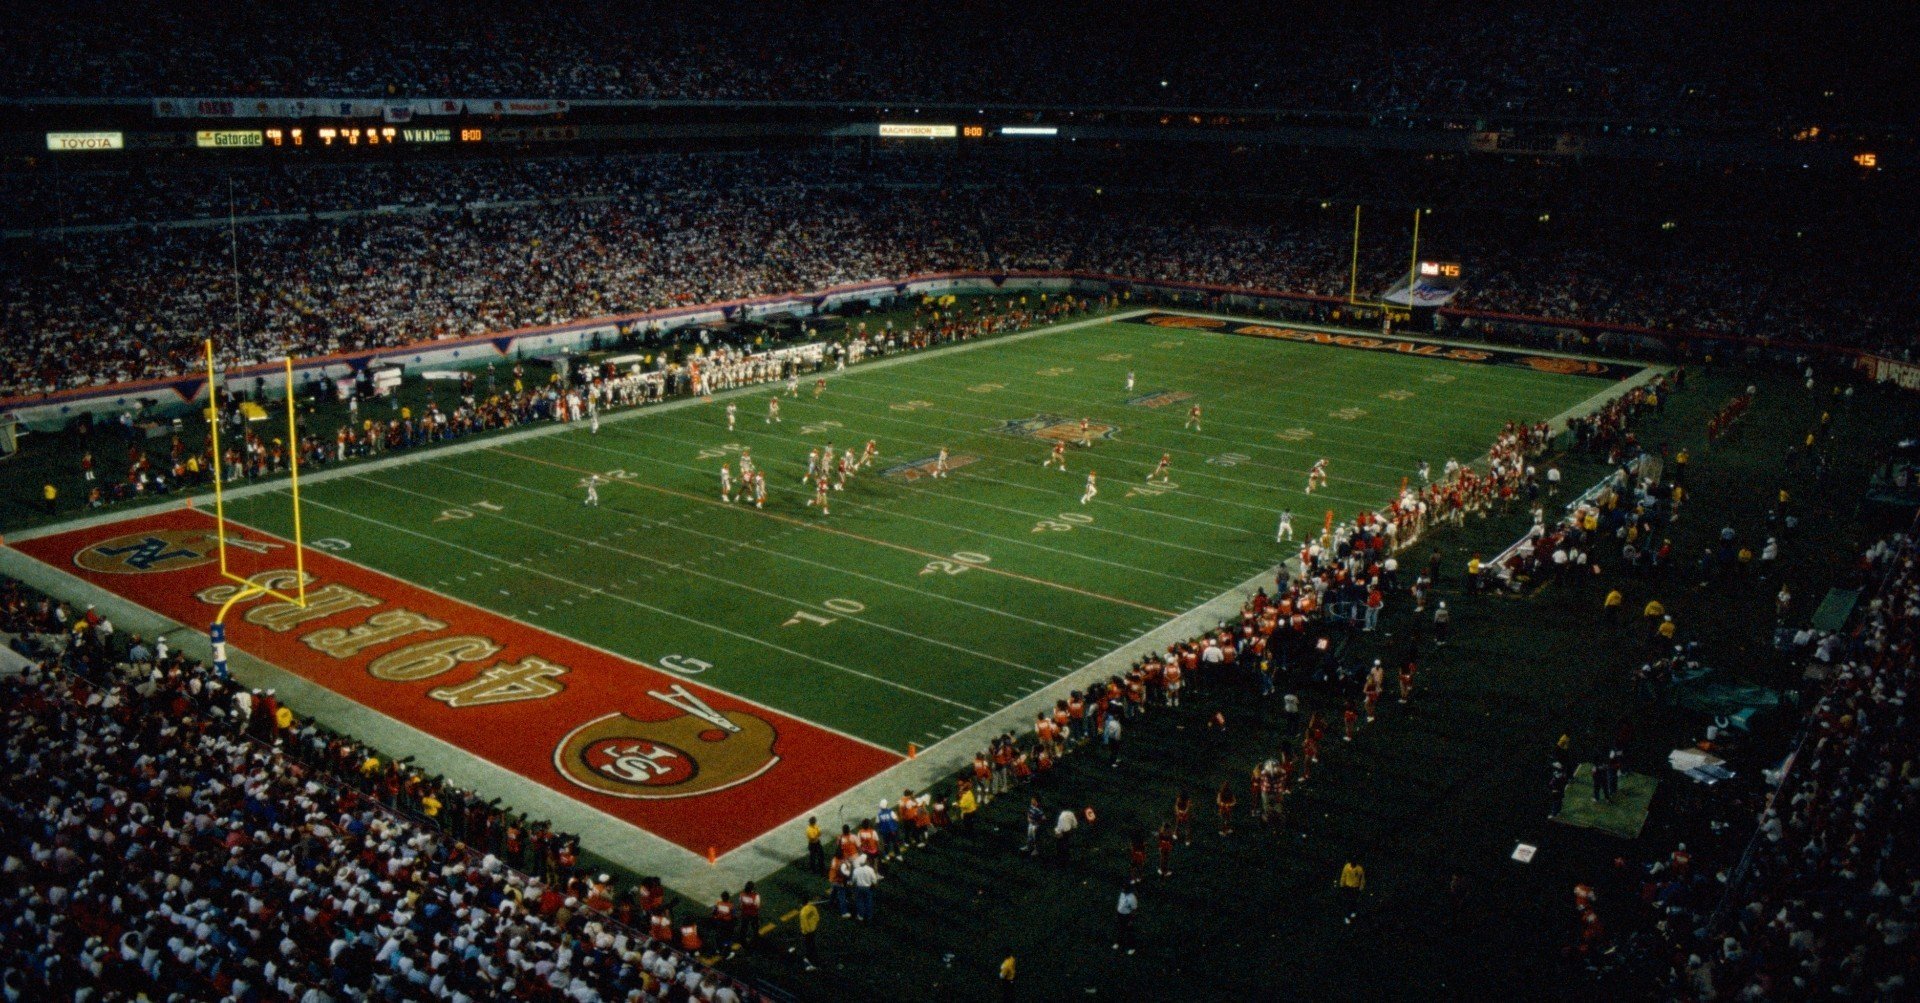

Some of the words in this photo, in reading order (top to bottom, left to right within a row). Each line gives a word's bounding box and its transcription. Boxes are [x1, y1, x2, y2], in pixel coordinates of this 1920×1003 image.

[214, 132, 261, 145] Gatorade
[461, 129, 482, 141] 8:00
[60, 138, 112, 149] TOYOTA
[1853, 154, 1876, 167] 45
[1440, 264, 1460, 277] 45
[1036, 512, 1094, 532] 30
[925, 551, 991, 575] 20
[795, 598, 866, 628] 10
[658, 653, 715, 675] G
